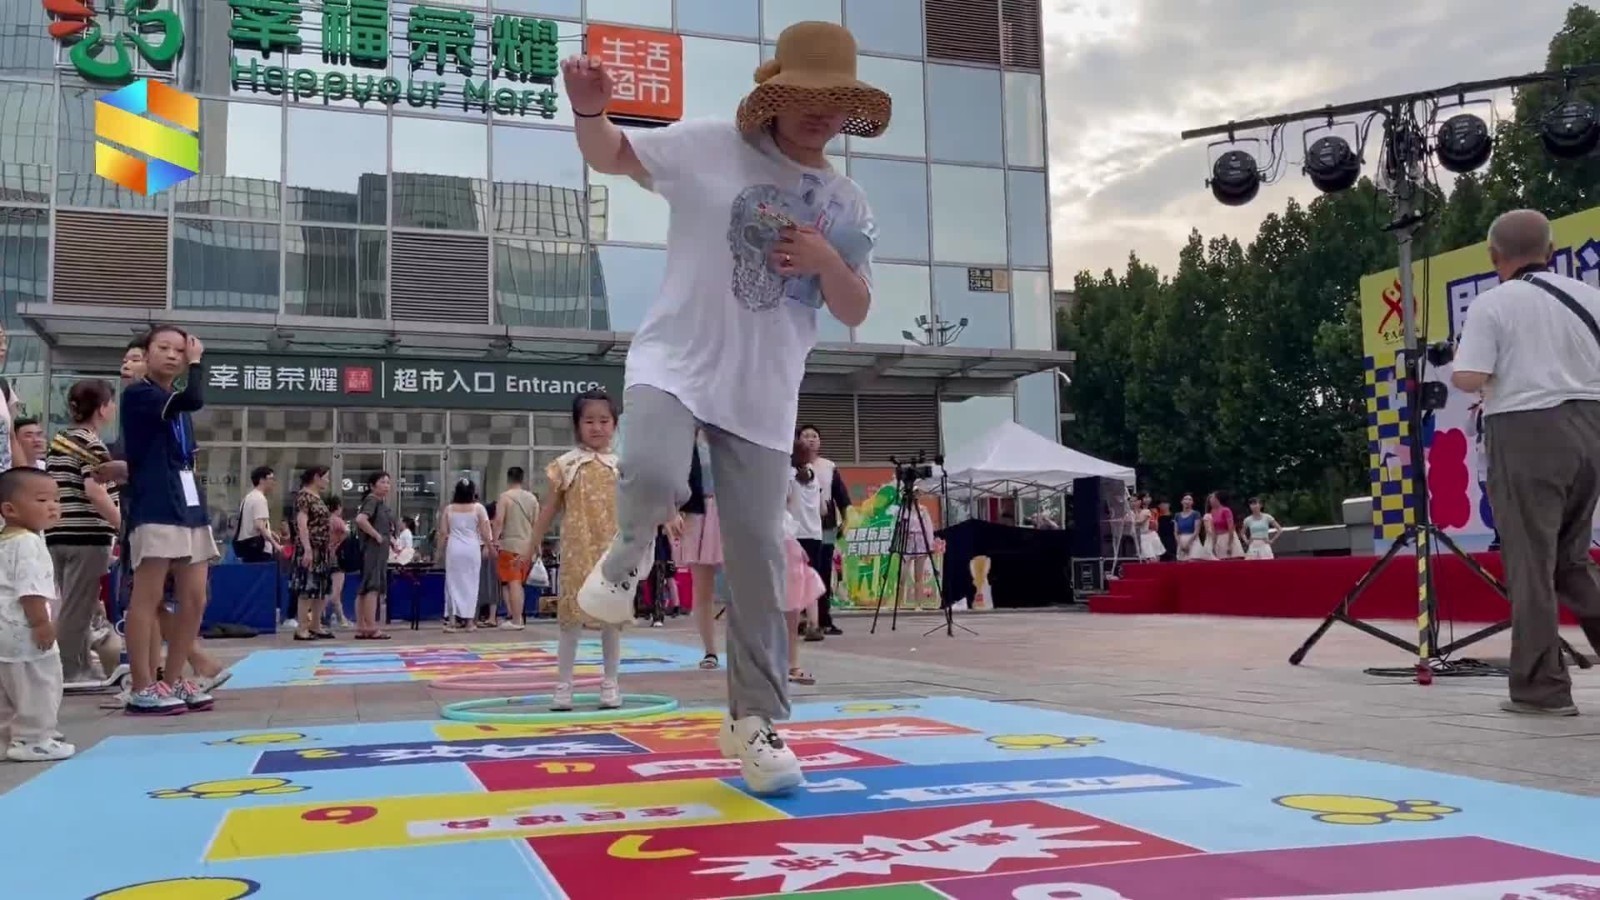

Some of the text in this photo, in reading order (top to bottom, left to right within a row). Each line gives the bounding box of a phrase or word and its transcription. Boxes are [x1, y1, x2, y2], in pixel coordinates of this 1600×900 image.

[228, 0, 559, 77] 幸福荣耀
[602, 37, 670, 72] 生活
[231, 56, 559, 116] Happyour Mart
[606, 69, 671, 104] 超市
[209, 364, 338, 392] 幸福荣耀
[393, 369, 495, 393] 超市入口
[506, 375, 601, 395] Entrance
